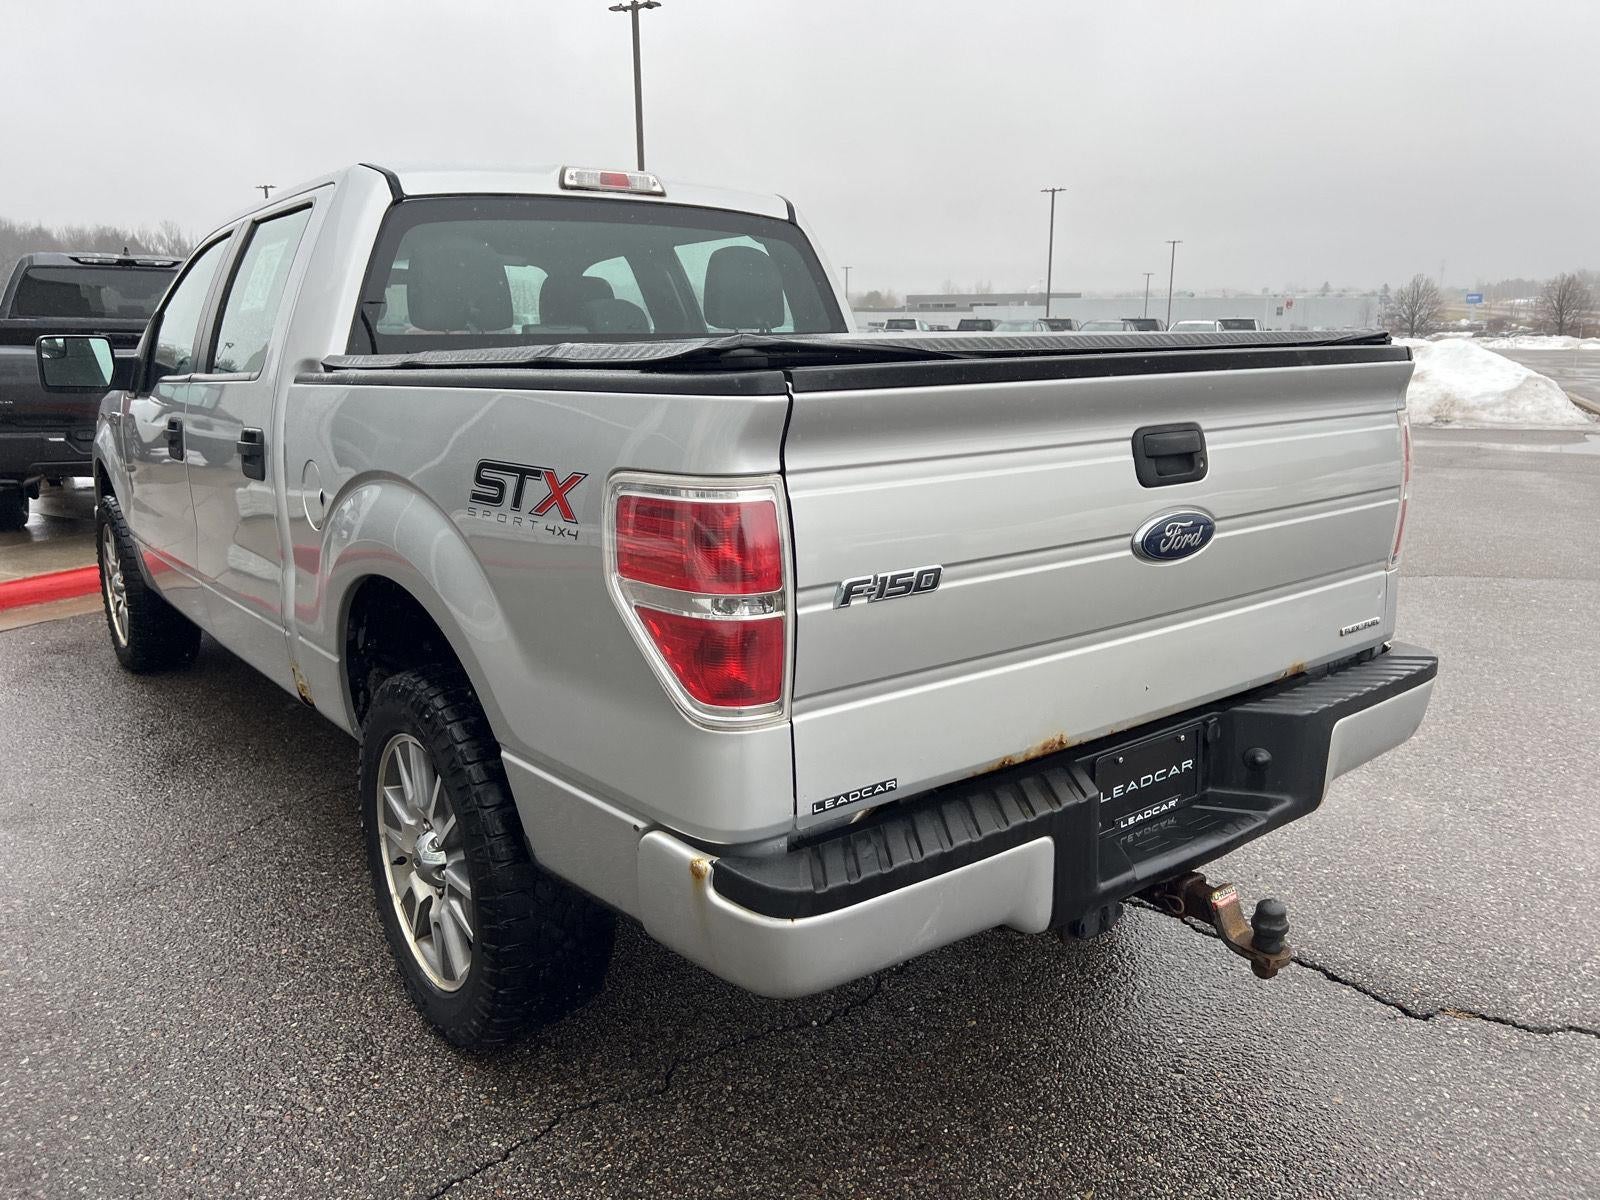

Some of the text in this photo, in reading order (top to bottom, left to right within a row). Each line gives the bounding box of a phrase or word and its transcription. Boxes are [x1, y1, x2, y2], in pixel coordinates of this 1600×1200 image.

[469, 458, 589, 524] STX
[467, 506, 538, 530] SPORT
[1160, 520, 1204, 553] Ford
[834, 565, 943, 609] F-150
[813, 780, 897, 813] LEADCAR
[1100, 759, 1194, 803] LEADCAR
[1120, 798, 1178, 828] LEADCAR
